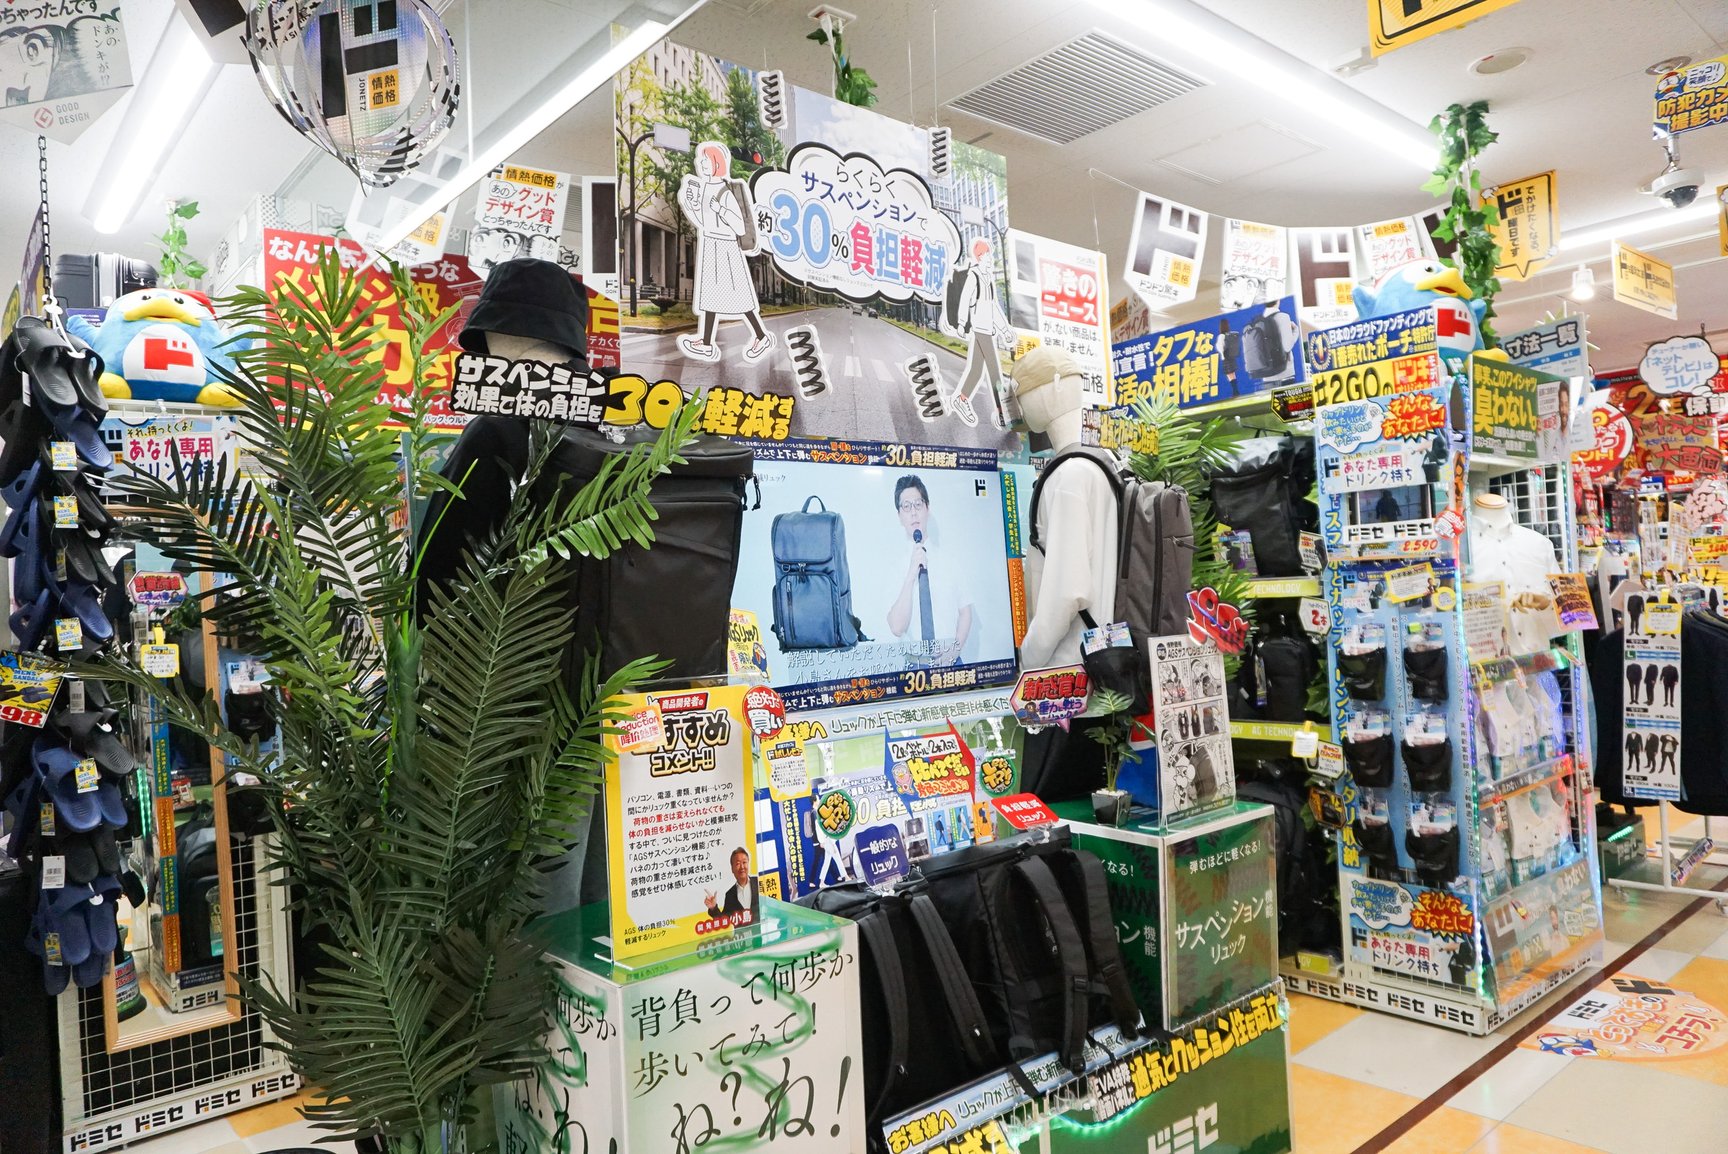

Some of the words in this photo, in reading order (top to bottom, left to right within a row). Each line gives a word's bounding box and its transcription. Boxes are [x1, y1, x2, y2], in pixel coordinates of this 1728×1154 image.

[371, 74, 396, 91] 情熱
[56, 103, 79, 114] GOOD
[372, 90, 397, 106] 価格
[59, 112, 90, 125] DESIGN
[836, 161, 896, 199] らくらく
[484, 196, 555, 225] デザイン賞
[801, 170, 928, 231] サスペンションで
[1042, 262, 1098, 300] 驚きの
[1043, 295, 1099, 325] ニュース
[1153, 329, 1214, 367] タフな
[1506, 321, 1579, 360] 寸法一覧
[459, 354, 608, 397] サスペンション
[1664, 373, 1701, 389] コレ!
[452, 383, 604, 424] 効果で体の負担を
[1391, 394, 1432, 413] そんな
[1382, 407, 1446, 438] あなたに!
[1344, 454, 1403, 474] あなた専用
[1346, 468, 1414, 487] ドリンク持ち
[1348, 526, 1385, 542] ドミセ
[1393, 522, 1433, 540] ドミセ
[0, 704, 43, 727] 98
[661, 697, 704, 711] 商品開発者の
[620, 715, 659, 732] eduction
[663, 712, 729, 747] すすめ
[747, 708, 784, 736] 買い
[628, 813, 739, 839] 体の負担を減らせないかと模索研究
[633, 805, 726, 827] 荷物の重さは変えられなくても
[1016, 810, 1047, 823] リュック
[629, 827, 723, 850] する中で、ついに見つけたのが
[860, 836, 899, 855] 一般的な
[870, 857, 899, 875] リュック
[1189, 840, 1261, 875] 弾むほどに軽くなる!
[630, 862, 713, 887] 荷物の重さから軽減される
[631, 871, 723, 898] 感覚をぜひ体感してください!
[1419, 892, 1462, 912] そんな
[624, 926, 637, 935] AGS
[696, 917, 729, 934] 開発担当
[730, 910, 753, 927] 小島
[1175, 896, 1264, 950] サスペンション
[1410, 910, 1474, 933] あなたに!
[624, 930, 667, 945] 軽減するリュック
[1143, 925, 1157, 957] 機能
[1211, 934, 1247, 964] リュック
[1370, 936, 1431, 961] あなた専用
[1372, 951, 1440, 976] ドリンク持ち
[631, 950, 854, 1042] 背負って何歩か
[1306, 979, 1341, 998] ドミセ
[1343, 982, 1379, 1002] ドミセ
[1387, 992, 1425, 1014] ドミセ
[1434, 1003, 1475, 1027] ドミセ
[632, 1002, 818, 1100] 歩いてみて!
[1130, 991, 1284, 1099] 通気とクッション性を両立
[71, 1123, 123, 1152] ドミセ
[135, 1105, 184, 1133] ドミセ
[195, 1089, 242, 1115] ドミセ
[251, 1073, 296, 1098] ドミセ
[887, 1108, 957, 1154] お客様へ
[1147, 1101, 1220, 1154] ドミセ
